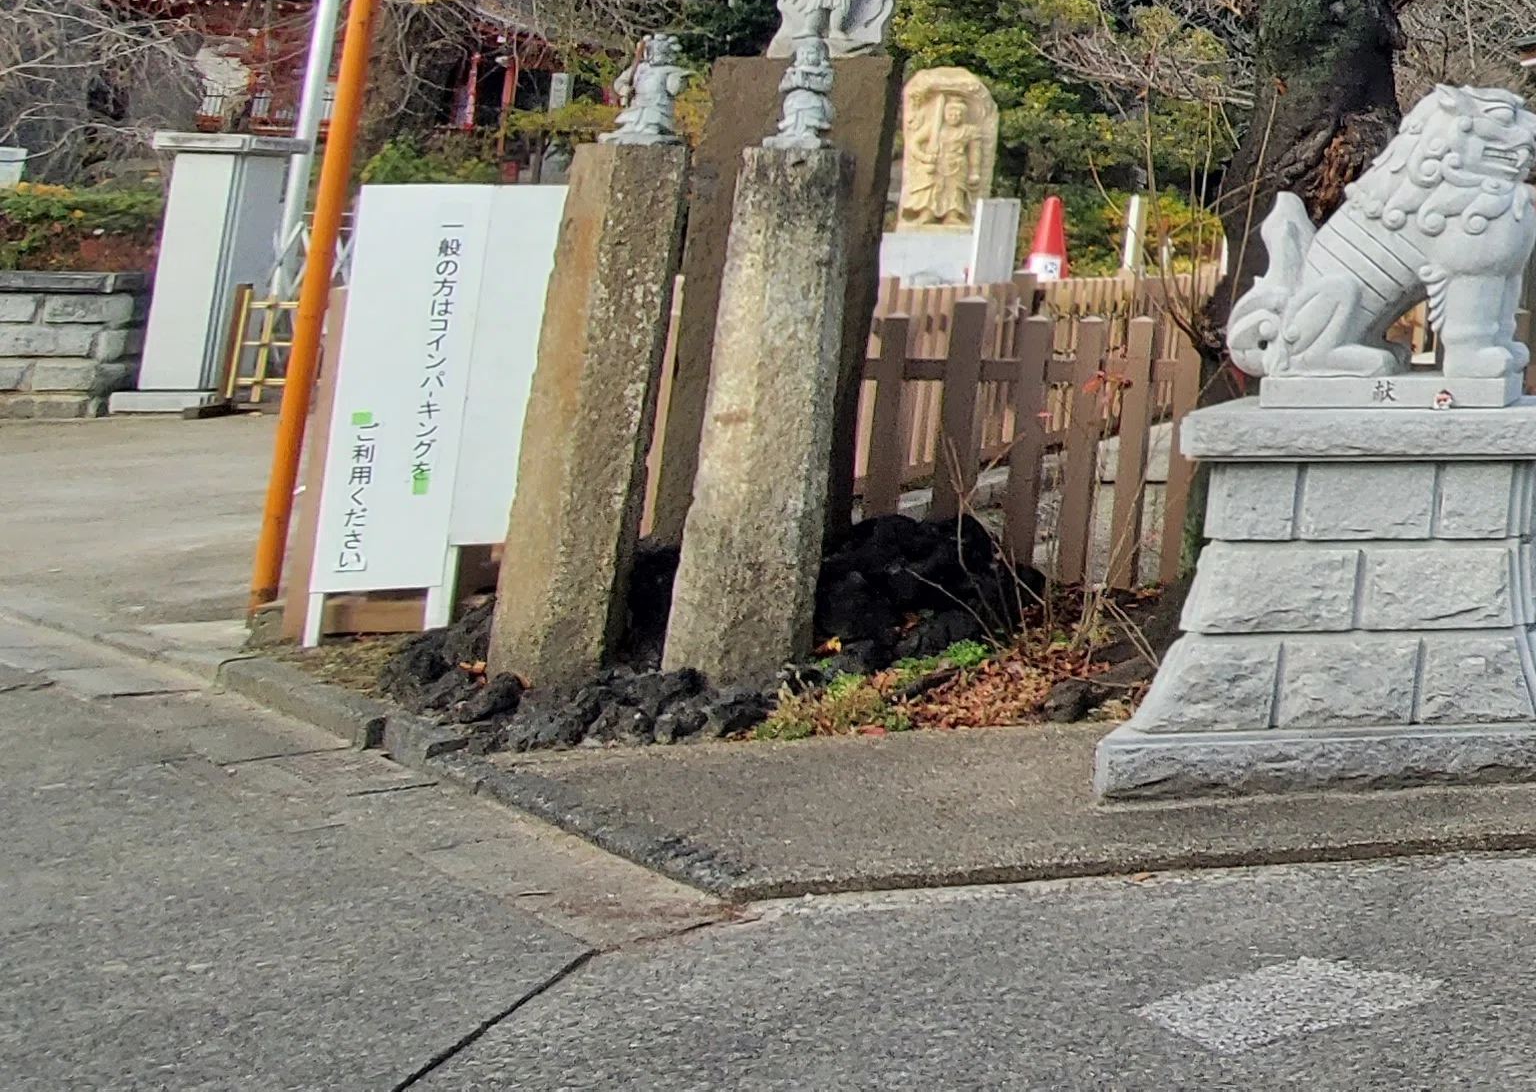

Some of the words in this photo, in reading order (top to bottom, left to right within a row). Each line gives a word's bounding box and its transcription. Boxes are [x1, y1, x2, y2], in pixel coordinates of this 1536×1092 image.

[410, 221, 465, 481] 一般の方はコインパーキングを
[1372, 380, 1397, 403] 献
[338, 422, 380, 568] ご利用ください
